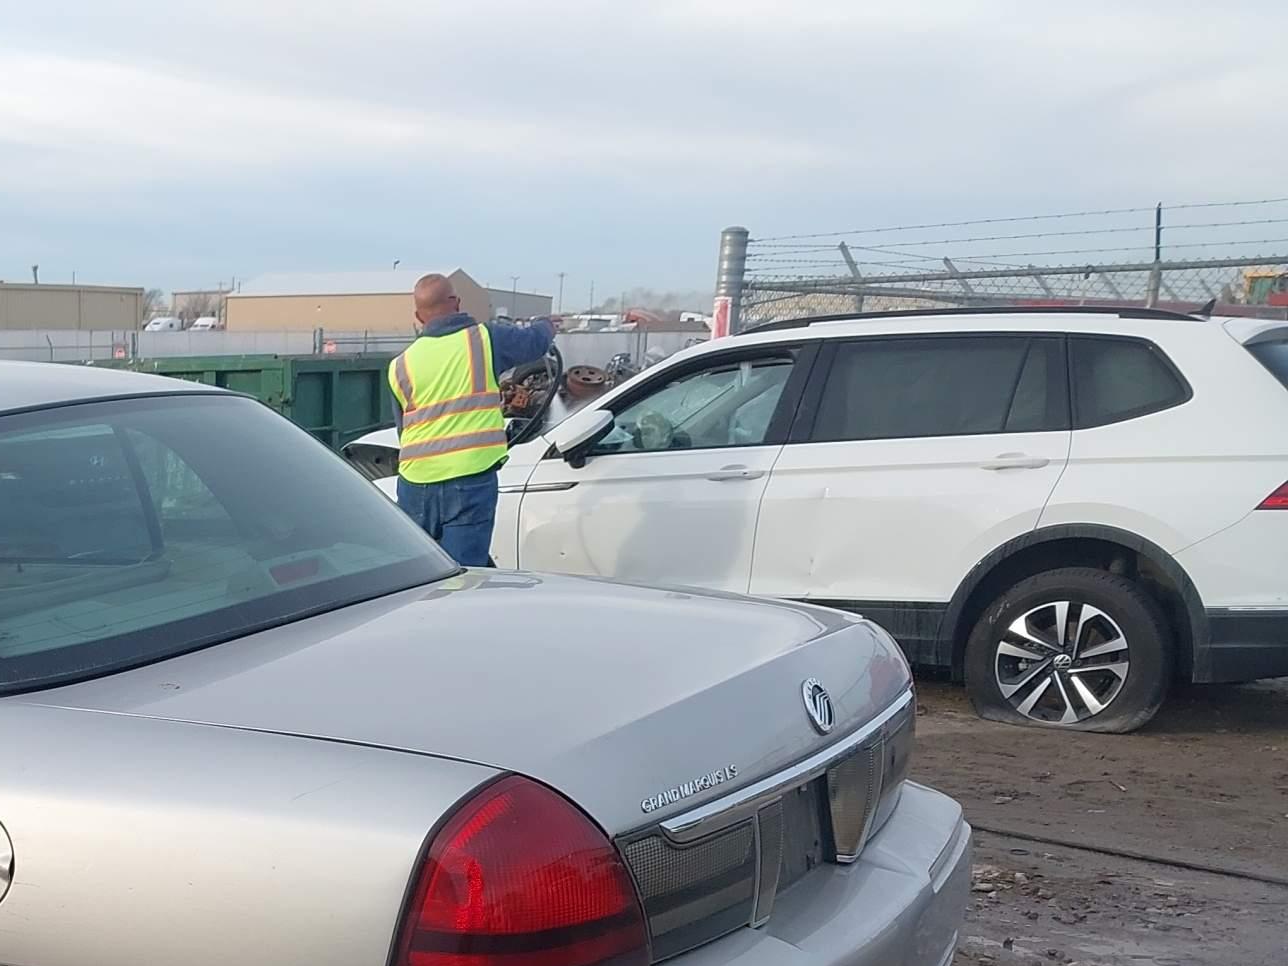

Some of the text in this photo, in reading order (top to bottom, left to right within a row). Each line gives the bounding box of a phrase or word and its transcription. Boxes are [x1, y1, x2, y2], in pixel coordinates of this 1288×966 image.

[641, 764, 739, 814] GRAND MARQUIS LS
